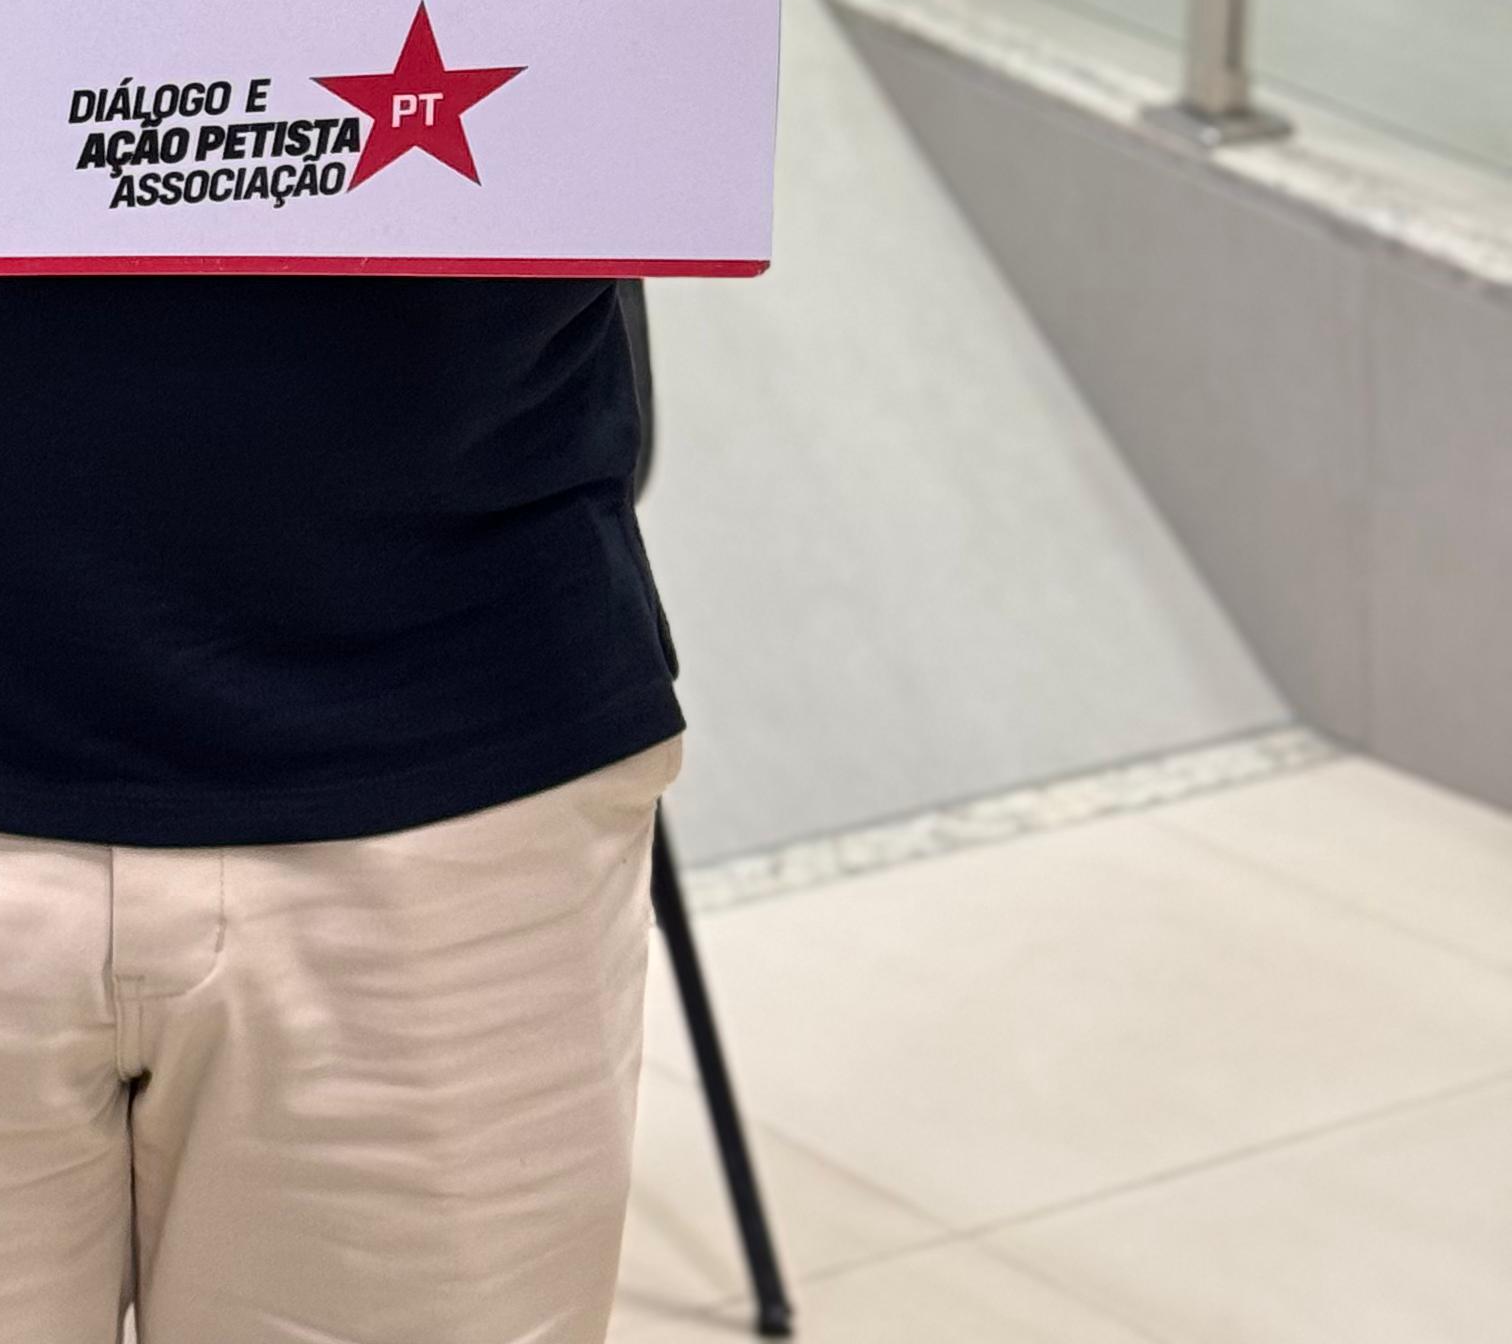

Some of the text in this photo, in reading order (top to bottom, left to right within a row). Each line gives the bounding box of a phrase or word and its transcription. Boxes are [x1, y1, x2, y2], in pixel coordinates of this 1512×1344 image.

[68, 77, 271, 124] DIÁLOGO E
[391, 92, 444, 128] PT
[75, 116, 361, 179] AÇÃO PETISTA
[108, 154, 346, 209] ASSOCIAÇÃO
